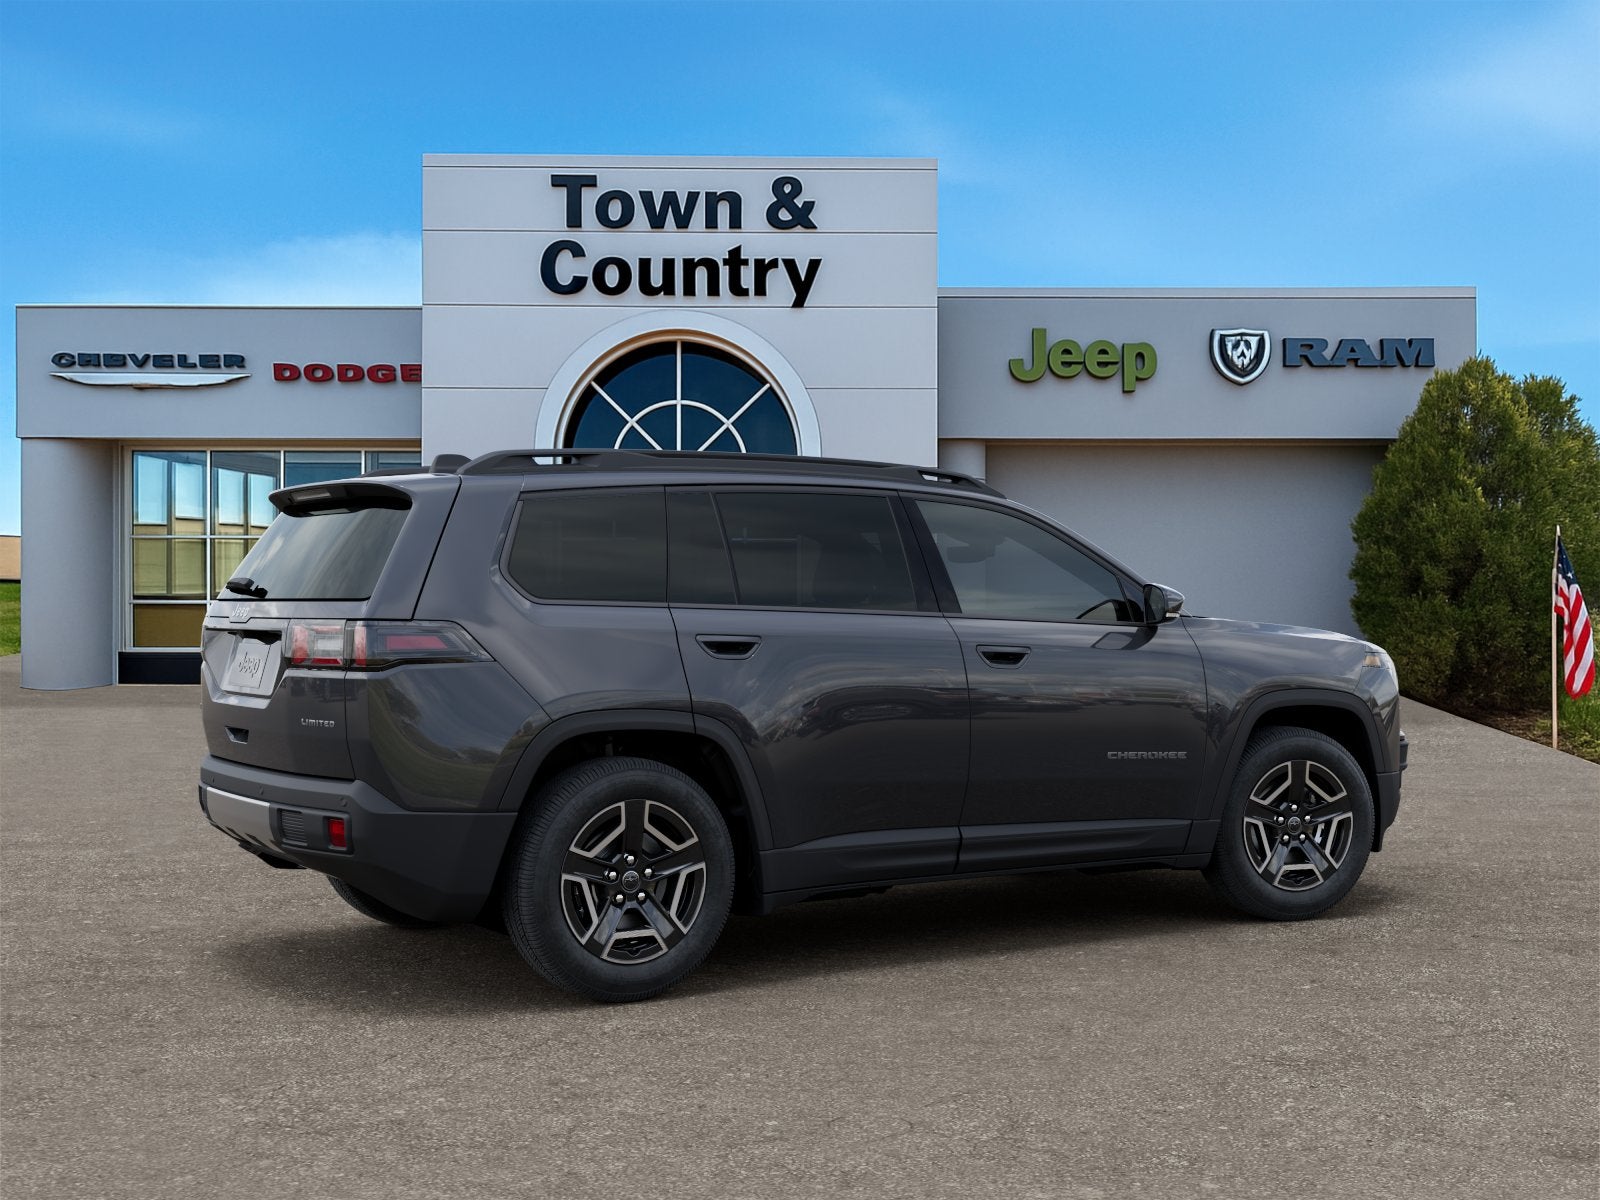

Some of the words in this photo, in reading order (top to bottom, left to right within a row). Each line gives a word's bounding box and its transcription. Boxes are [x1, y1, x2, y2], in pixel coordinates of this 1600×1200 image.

[550, 174, 743, 229] Town
[765, 175, 818, 229] &
[540, 239, 822, 308] Country
[1009, 327, 1157, 392] Jeep
[1283, 338, 1435, 367] RAM
[272, 363, 422, 383] DODGE
[232, 604, 250, 618] Jeep
[238, 651, 261, 679] Jeep
[300, 718, 335, 728] LIMITED
[1107, 751, 1187, 760] CHEROKEE
